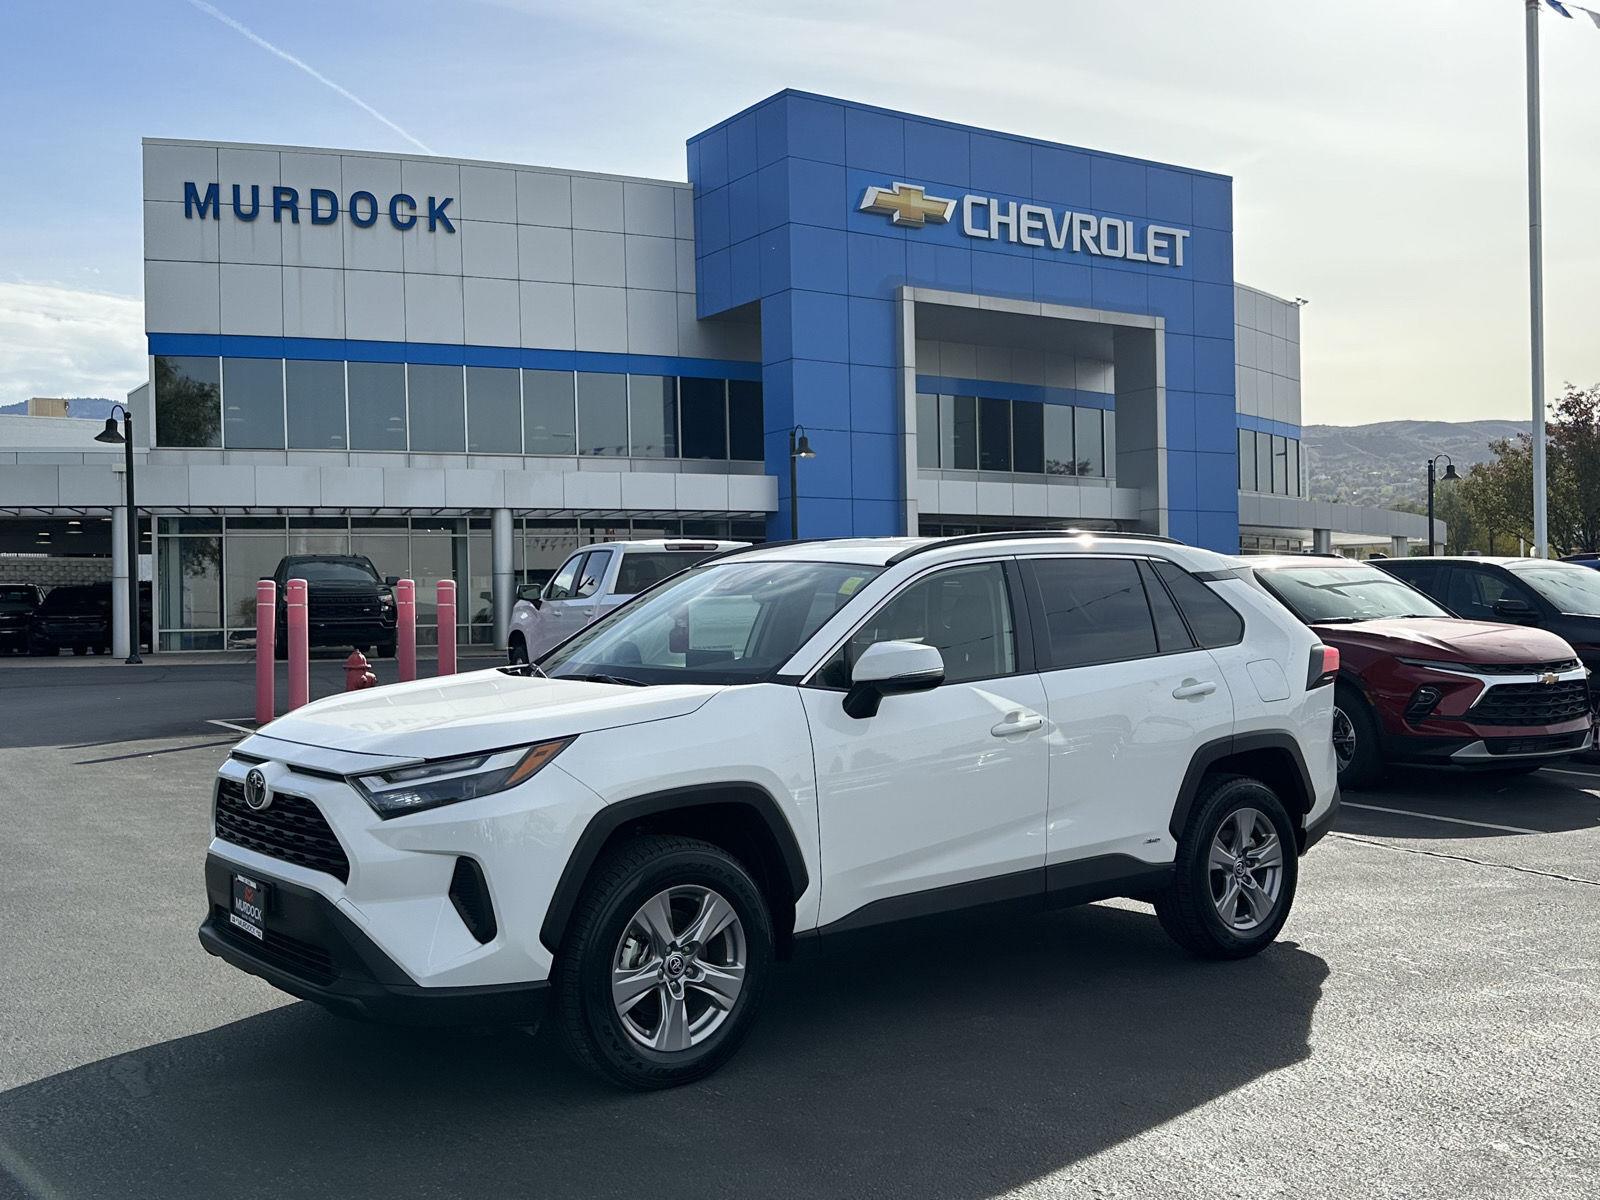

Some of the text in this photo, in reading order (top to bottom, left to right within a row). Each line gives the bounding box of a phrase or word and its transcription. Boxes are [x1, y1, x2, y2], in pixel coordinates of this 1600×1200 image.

[184, 181, 456, 233] MURDOCK
[963, 194, 1190, 267] CHEVROLET
[235, 897, 262, 921] MURDOCK
